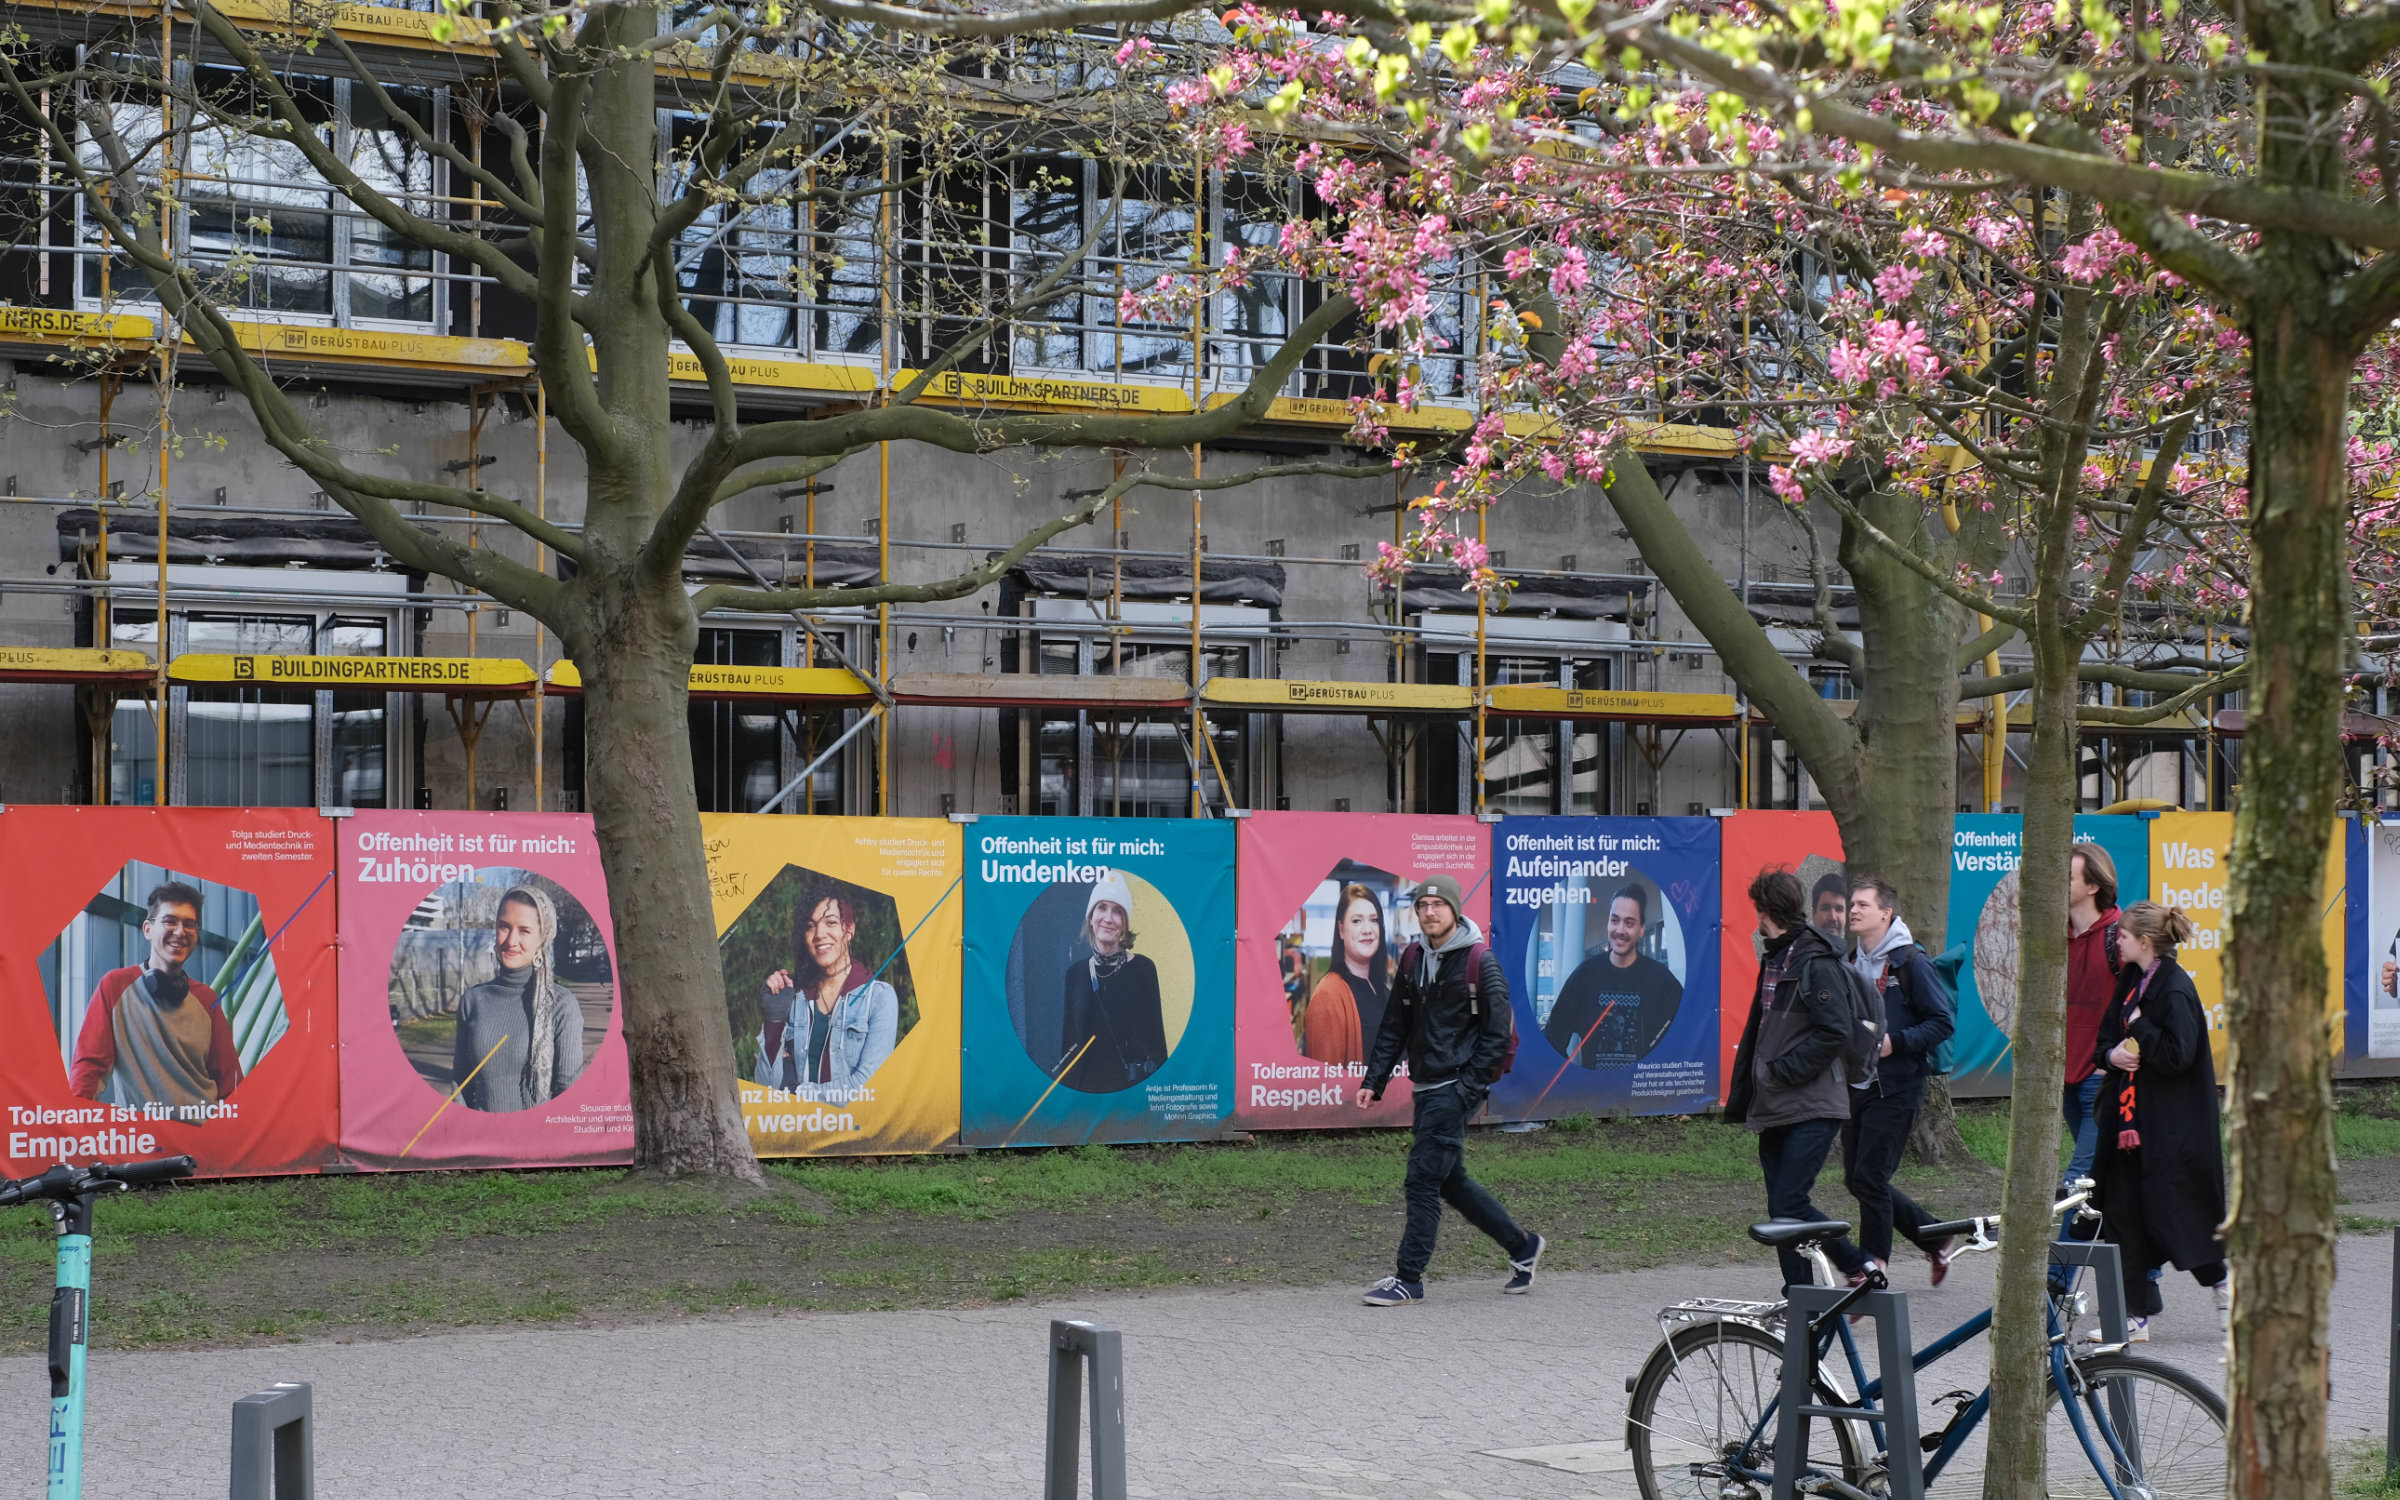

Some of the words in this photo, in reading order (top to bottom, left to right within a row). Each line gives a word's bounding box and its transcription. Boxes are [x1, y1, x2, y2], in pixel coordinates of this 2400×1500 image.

[396, 16, 428, 30] PLUS
[0, 310, 84, 332] NERS.DE
[311, 333, 386, 351] GERÜSTBAU
[391, 340, 424, 353] PLUS
[750, 365, 780, 378] PLUS
[976, 378, 1140, 405] BUILDINGPARTNERS.DE
[271, 659, 469, 680] BUILDINGPARTNERS.DE
[689, 671, 751, 685] ERÜSTBAU
[754, 674, 785, 686] PLUS
[1309, 686, 1367, 700] GERÜSTBAU
[1370, 690, 1395, 700] PLUS
[1585, 695, 1639, 707] GERÜSTBAU
[255, 830, 285, 839] studiert
[1954, 831, 2017, 847] Offenheit
[226, 841, 242, 850] und
[243, 841, 301, 850] Medientechnik
[303, 841, 314, 850] im
[358, 832, 454, 852] Offenheit
[459, 834, 484, 853] ist
[488, 834, 517, 853] für
[522, 835, 576, 854] mich:
[981, 836, 1062, 855] Offenheit
[1066, 837, 1088, 855] ist
[1091, 837, 1116, 855] für
[1119, 838, 1165, 856] mich:
[1506, 835, 1574, 851] Offenheit
[1577, 835, 1595, 851] ist
[1598, 835, 1618, 851] für
[1621, 835, 1661, 851] mich:
[241, 852, 273, 861] zweiten
[2161, 842, 2215, 870] Was
[1506, 855, 1629, 878] Aufeinander
[1251, 1062, 1320, 1079] Toleranz
[1324, 1061, 1343, 1079] ist
[767, 1086, 791, 1104] ist
[795, 1086, 823, 1103] für
[824, 1084, 876, 1103] mich:
[1204, 1093, 1218, 1101] und
[8, 1105, 104, 1126] Toleranz
[110, 1103, 137, 1123] ist
[143, 1101, 174, 1121] für
[179, 1099, 239, 1120] mich:
[545, 1115, 586, 1124] Architektur
[588, 1114, 603, 1123] und
[573, 1125, 605, 1134] Studium
[606, 1125, 621, 1133] und
